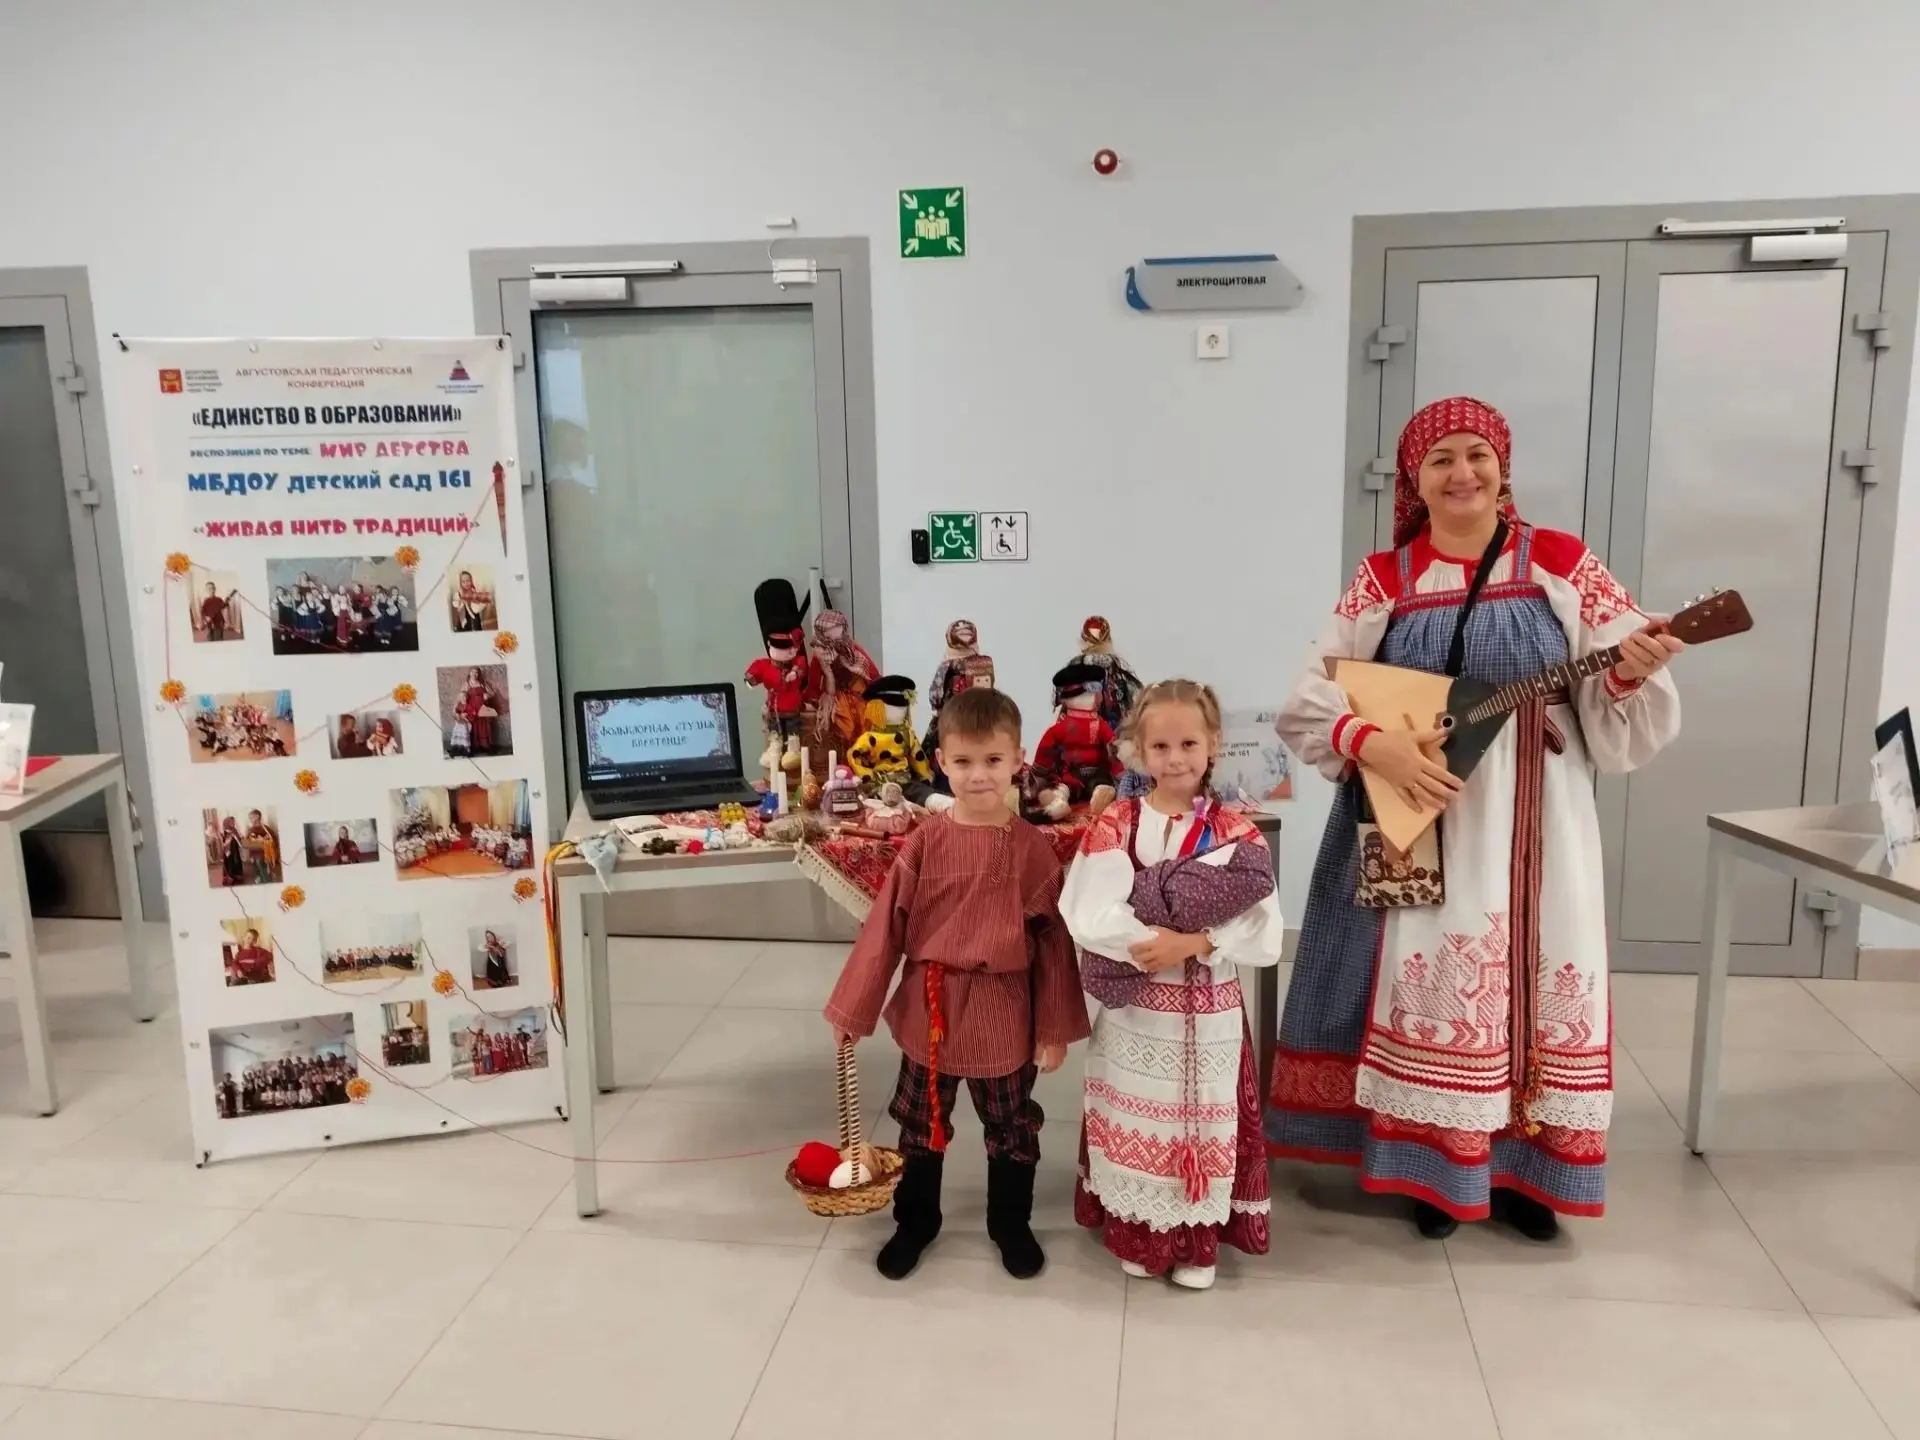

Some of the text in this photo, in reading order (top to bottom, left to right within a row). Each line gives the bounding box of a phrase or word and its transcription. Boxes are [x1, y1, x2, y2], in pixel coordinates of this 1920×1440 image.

[1176, 276, 1266, 287] ЭЛЕКТРОЩИТОВАЯ
[235, 366, 413, 377] АВГУСТОВСКАЯ ПЕДАГОГИЧЕСКАЯ
[287, 379, 365, 389] КОНФЕРЕНЦИЯ
[192, 404, 462, 428] «ЕДИНСТВО В ОБРАЗОВАНИИ»
[263, 448, 278, 456] ПО
[319, 440, 470, 459] МИР ДЕТСТВА
[187, 472, 278, 495] МБДОУ
[438, 469, 471, 488] 161
[193, 512, 480, 537] «ЖИВАЯ НИТЬ ТРАДИЦИЙ»
